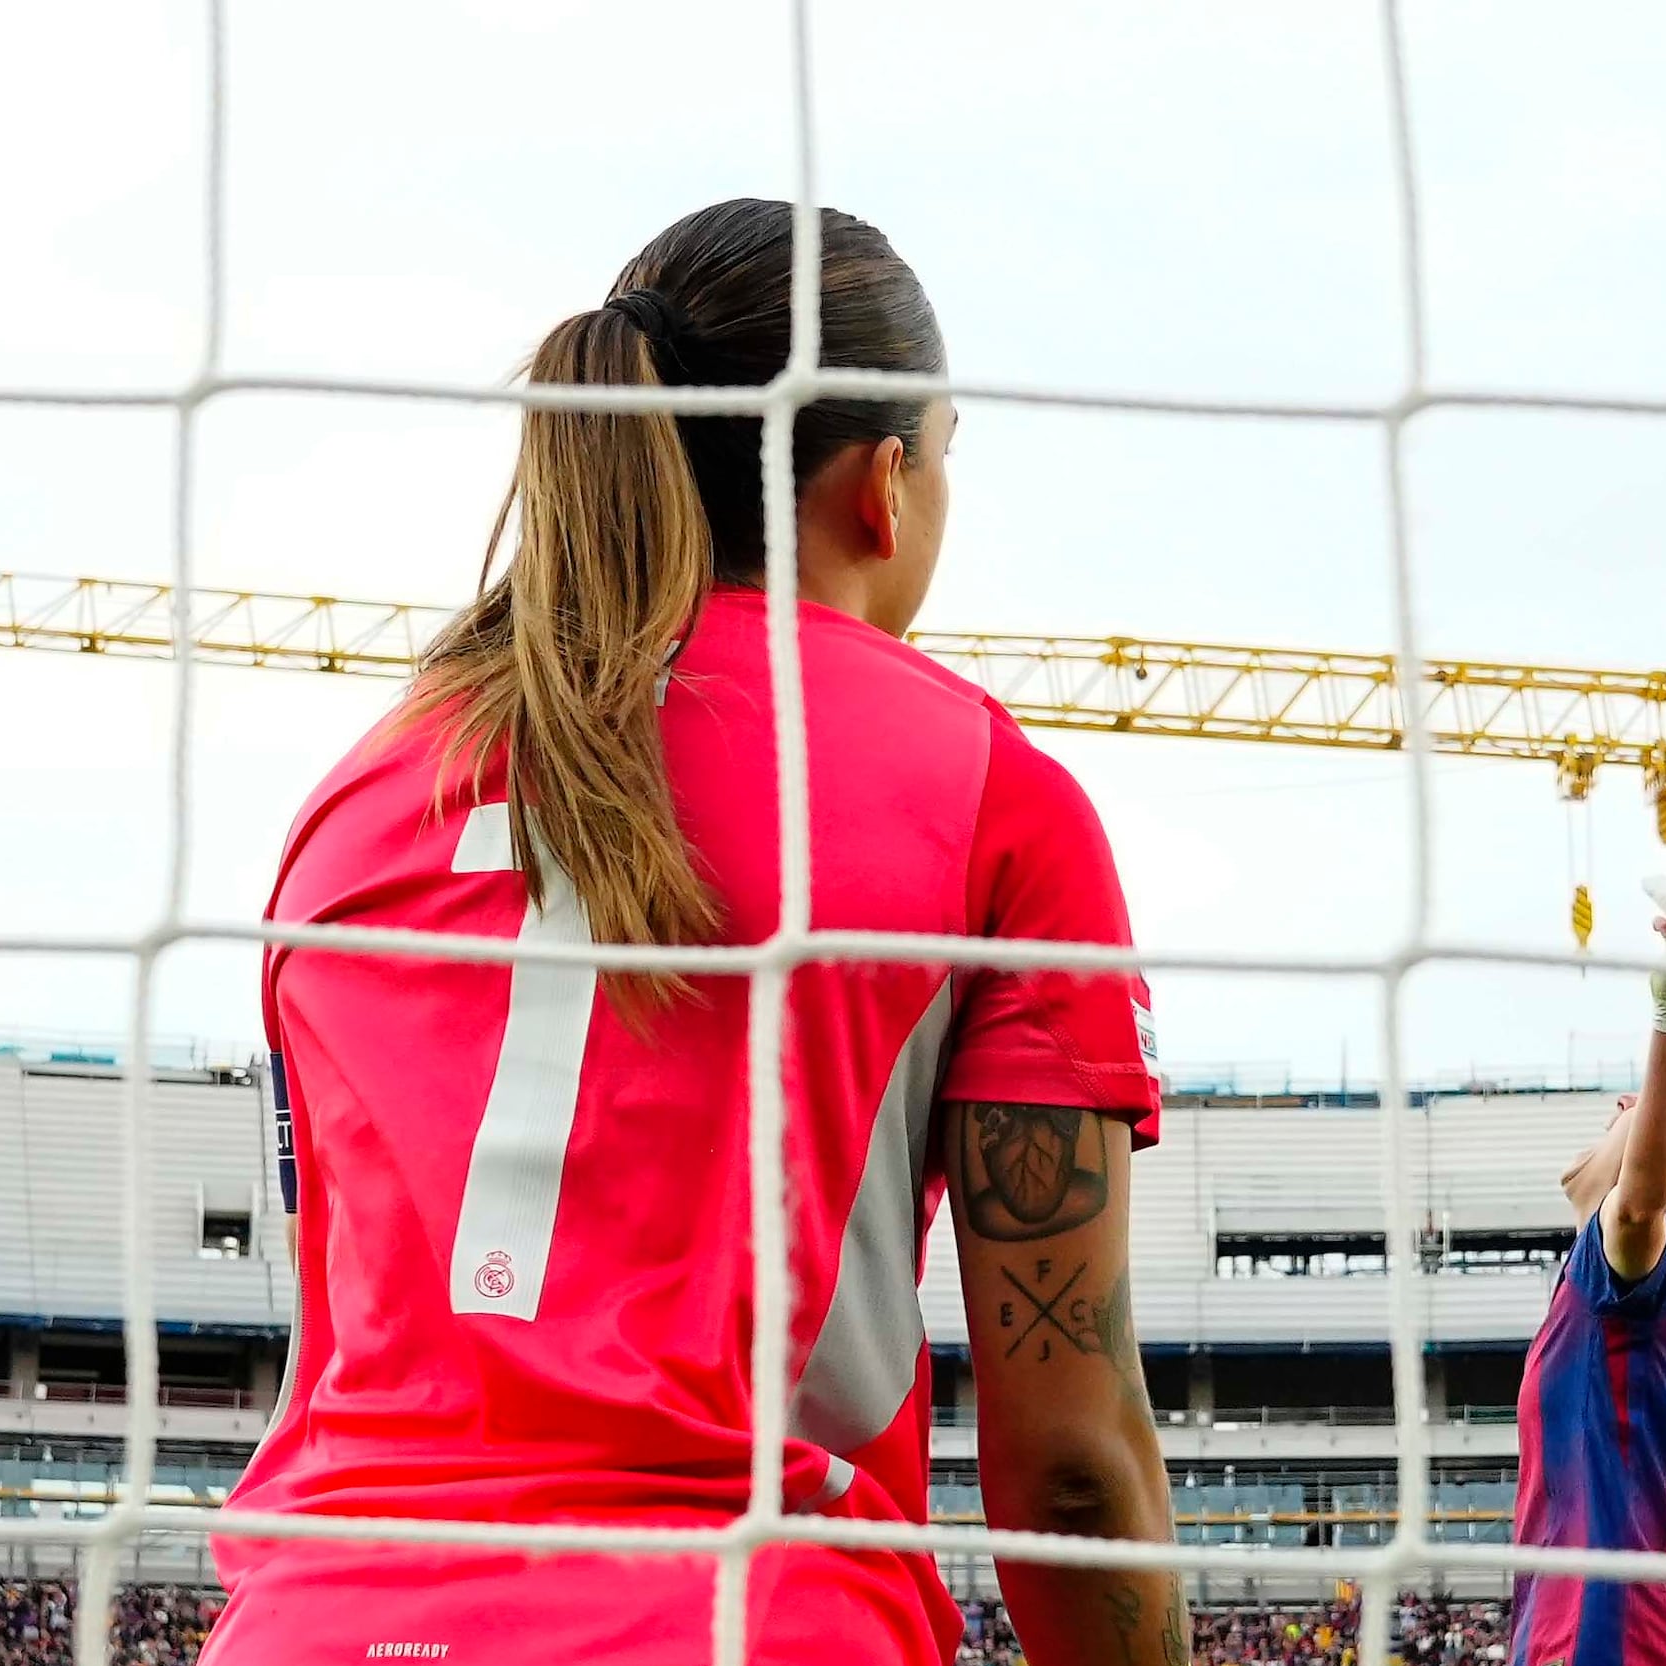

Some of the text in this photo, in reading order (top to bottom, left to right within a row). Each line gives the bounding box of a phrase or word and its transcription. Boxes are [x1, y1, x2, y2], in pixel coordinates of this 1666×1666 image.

[1037, 1259, 1051, 1282] F
[1000, 1303, 1014, 1327] E
[1039, 1340, 1051, 1361] J
[366, 1642, 450, 1659] AEROREADY
